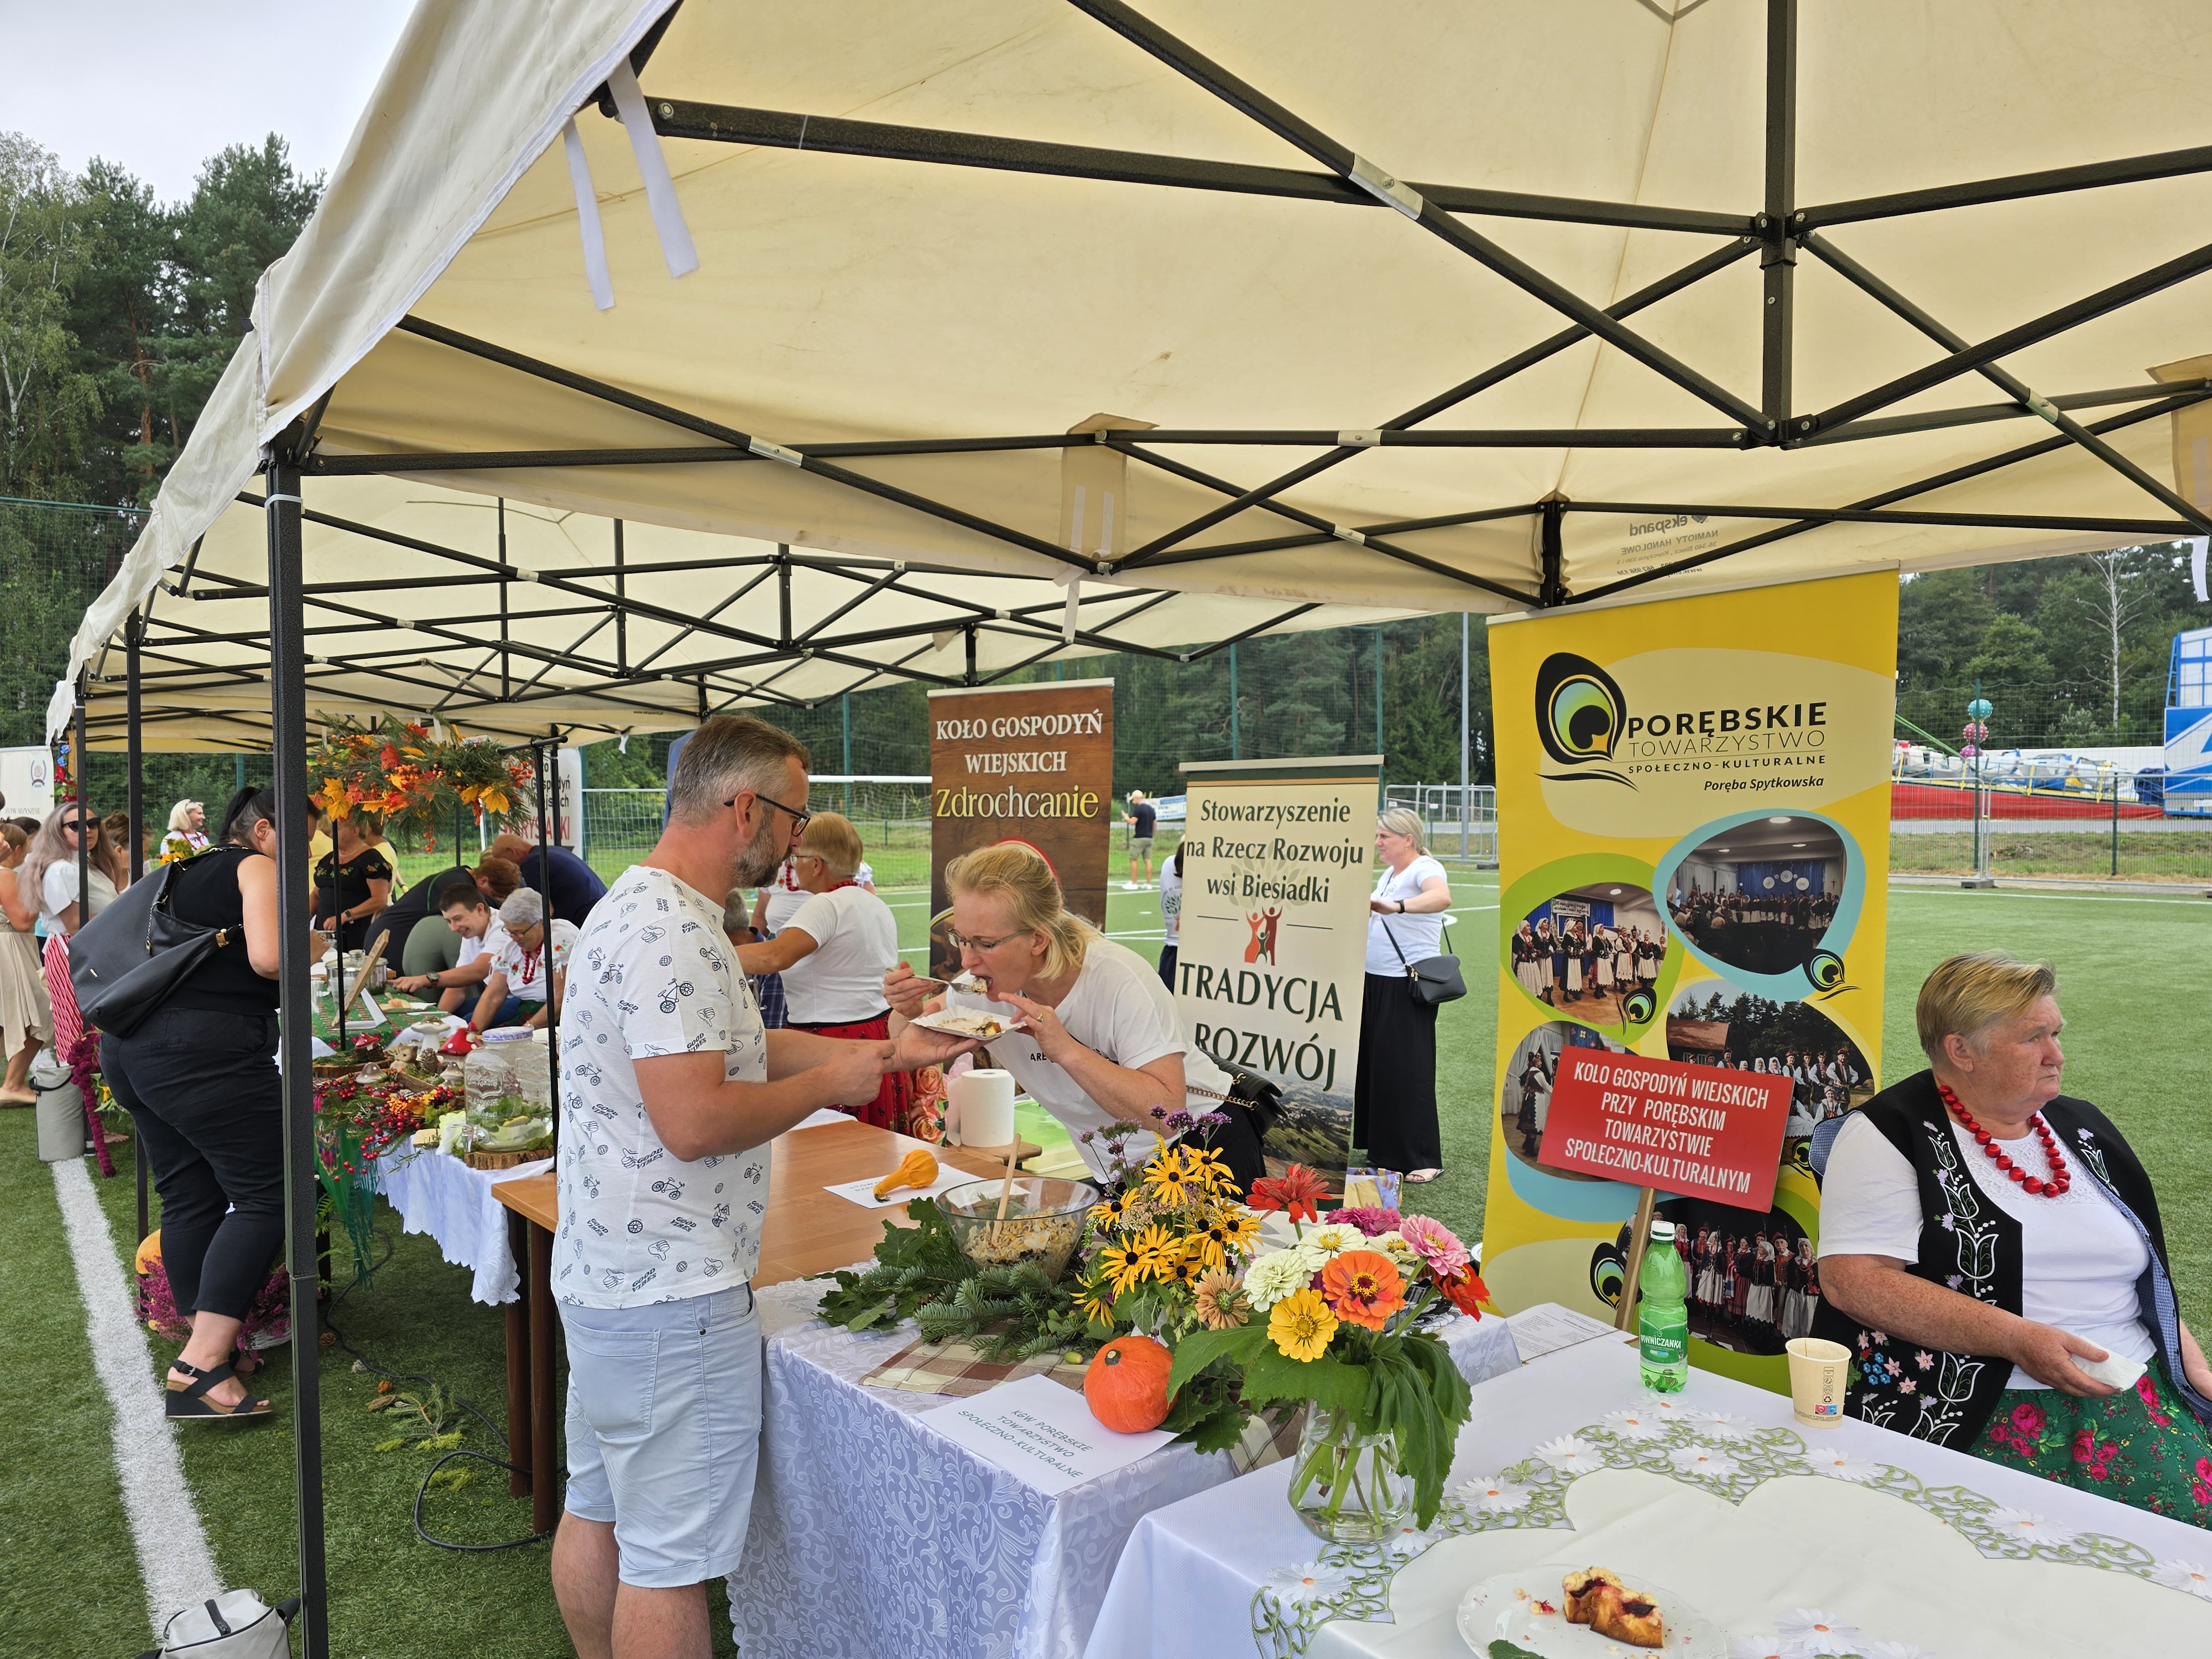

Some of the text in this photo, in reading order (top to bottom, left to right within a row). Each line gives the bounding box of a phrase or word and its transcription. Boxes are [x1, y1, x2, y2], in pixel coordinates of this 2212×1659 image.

[936, 708, 1103, 740] KOŁO GOSPODYŃ
[1628, 702, 1827, 738] PORĘBSKIE
[1629, 729, 1825, 758] TOWARZYSTWO
[964, 751, 1068, 776] WIEJSKICH
[1628, 754, 1826, 774] SPOŁECZNO-KULTURALNE
[1704, 775, 1824, 793] Poręba Spytkowska
[936, 784, 1100, 818] Zdrochcanie
[1201, 797, 1351, 828] Stowarzyszenie
[1186, 837, 1364, 870] na Rzecz Rozwoju
[1207, 874, 1236, 896] wsi
[1242, 874, 1330, 903] Biesiadki
[1179, 961, 1344, 1023] TRADYCJA
[619, 1000, 639, 1011] GOOD
[687, 1032, 705, 1049] GOOD
[1194, 1022, 1336, 1092] ROZWÓJ
[1574, 1061, 1770, 1109] KOŁO GOSPODYŃ WIEJSKICH
[592, 1106, 614, 1120] VIBES
[596, 1103, 618, 1116] GOOD
[1601, 1092, 1726, 1131] PRZY PORĘBSKIM
[1605, 1118, 1714, 1157] TOWARZYSTWIE
[637, 1147, 663, 1164] GOOD
[637, 1153, 663, 1169] VIBES
[1565, 1138, 1751, 1194] SPOŁECZNO-KULTURALNYM
[747, 1203, 761, 1214] VIBES
[752, 1200, 765, 1211] GOOD
[586, 1220, 604, 1237] VIBES
[591, 1218, 609, 1234] GOOD
[670, 1220, 692, 1233] VIBES
[676, 1217, 697, 1228] GOOD
[632, 1268, 656, 1287] GOOD
[632, 1273, 657, 1292] VIBES
[1641, 1334, 1682, 1349] PIWNICZANKA
[997, 1415, 1075, 1458] TOWARZYSTWO
[1011, 1410, 1093, 1452] KGW PORĘBSKIE
[958, 1410, 1084, 1478] SPOŁECZNO-KULTURALNE
